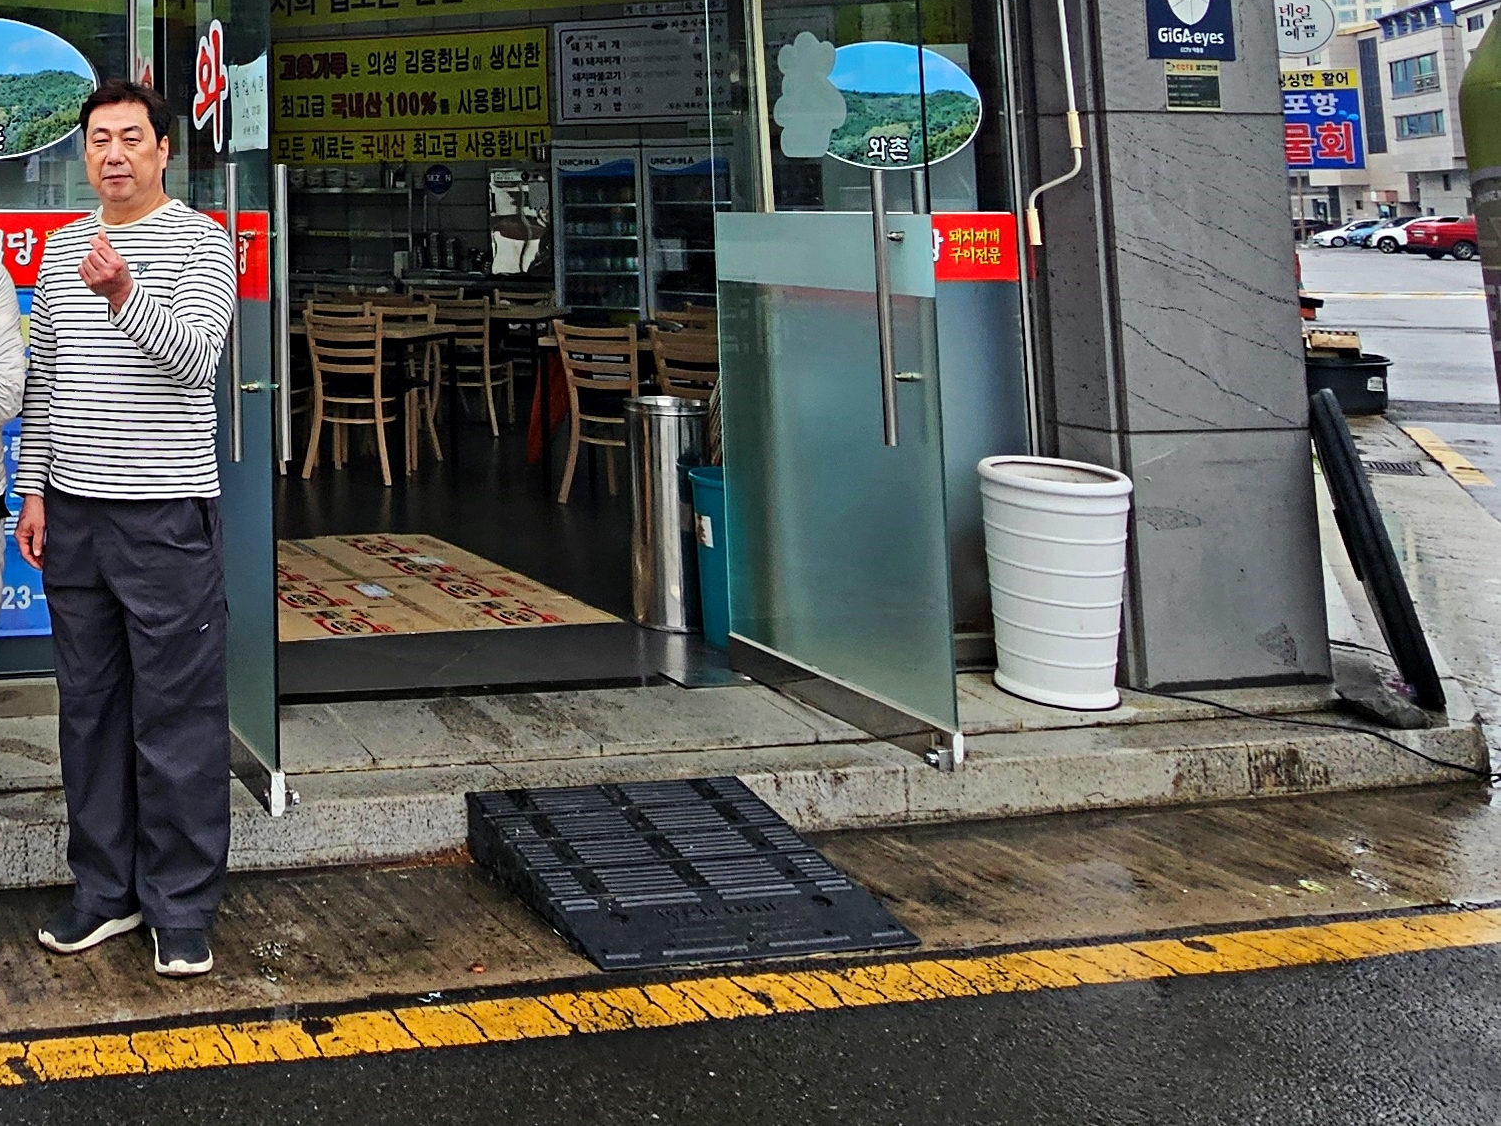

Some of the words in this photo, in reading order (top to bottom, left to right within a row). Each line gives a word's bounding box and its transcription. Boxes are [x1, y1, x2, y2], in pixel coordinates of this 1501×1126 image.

[1278, 2, 1312, 20] 네일
[367, 50, 397, 76] 의성
[489, 42, 541, 70] 생산한
[193, 24, 227, 149] 와
[1321, 72, 1349, 87] 활어
[280, 94, 325, 119] 최고급
[330, 91, 382, 119] 국내산
[457, 85, 542, 115] 사용합니다
[1284, 92, 1339, 116] 포항
[277, 137, 306, 160] 모든
[311, 135, 355, 160] 재료는
[360, 133, 406, 158] 국내산
[412, 132, 458, 158] 최고급
[464, 129, 546, 158] 사용합니다
[868, 136, 910, 162] 와촌
[1285, 121, 1356, 165] 물회
[426, 174, 451, 182] SEZN
[948, 227, 1001, 246] 돼지찌개
[948, 246, 1002, 265] 구이전문
